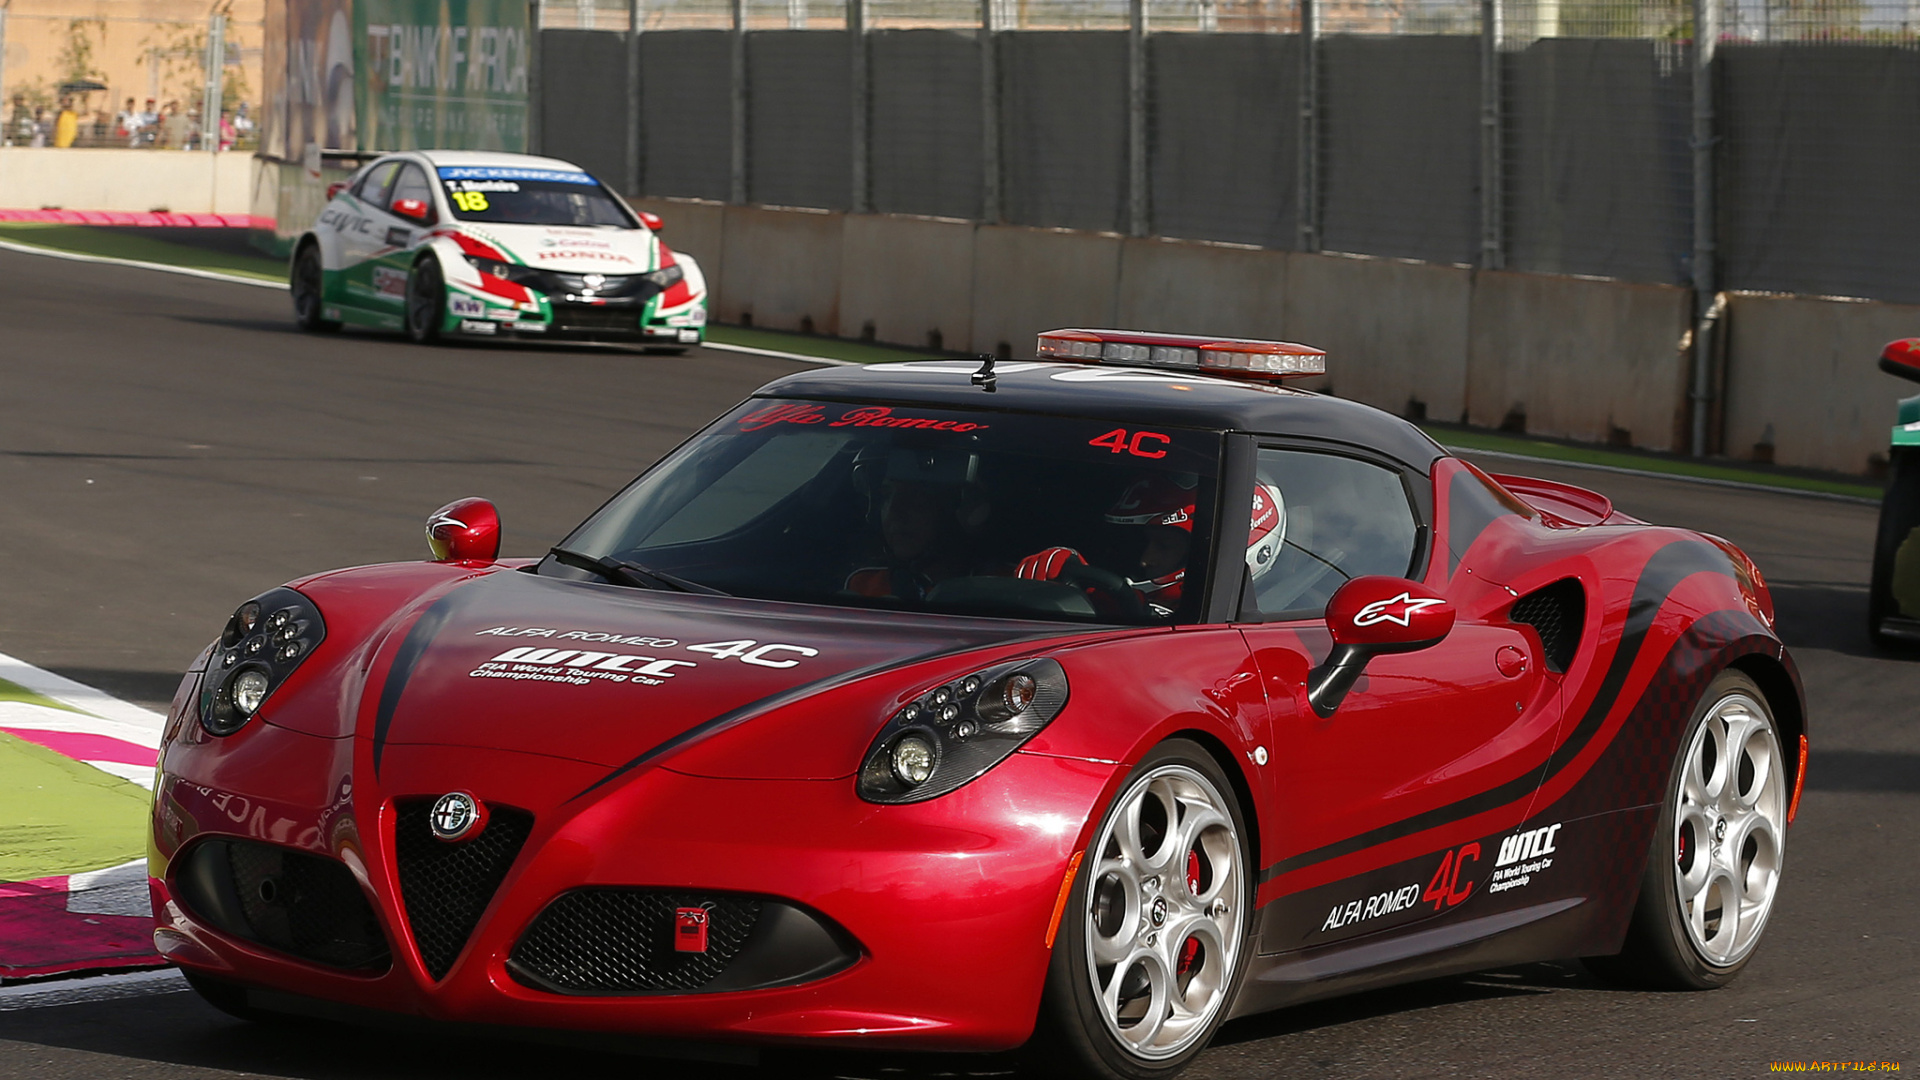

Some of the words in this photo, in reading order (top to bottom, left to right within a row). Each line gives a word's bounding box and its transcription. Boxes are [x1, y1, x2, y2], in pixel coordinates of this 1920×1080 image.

[389, 23, 438, 87] BANK
[465, 25, 528, 93] AFRICA
[452, 191, 489, 212] 18
[537, 250, 635, 265] HONDA
[737, 403, 826, 432] Alfa
[828, 406, 989, 433] Romeo
[1088, 428, 1171, 459] 4C
[475, 626, 557, 639] ALFA
[557, 631, 680, 648] ROMEO
[686, 639, 819, 669] 4C
[489, 646, 698, 678] WTCC
[469, 669, 591, 686] Championship
[478, 662, 507, 671] FIA
[511, 664, 564, 675] World
[565, 668, 629, 683] Touring
[630, 675, 665, 686] Car
[1494, 822, 1562, 867] WTCC
[1489, 874, 1530, 894] Championship
[1492, 870, 1503, 882] FIA
[1504, 865, 1521, 879] World
[1520, 861, 1542, 875] Touring
[1541, 857, 1553, 869] Car
[1321, 901, 1360, 931] ALFA
[1362, 883, 1420, 921] ROMEO
[1423, 841, 1481, 911] 4C
